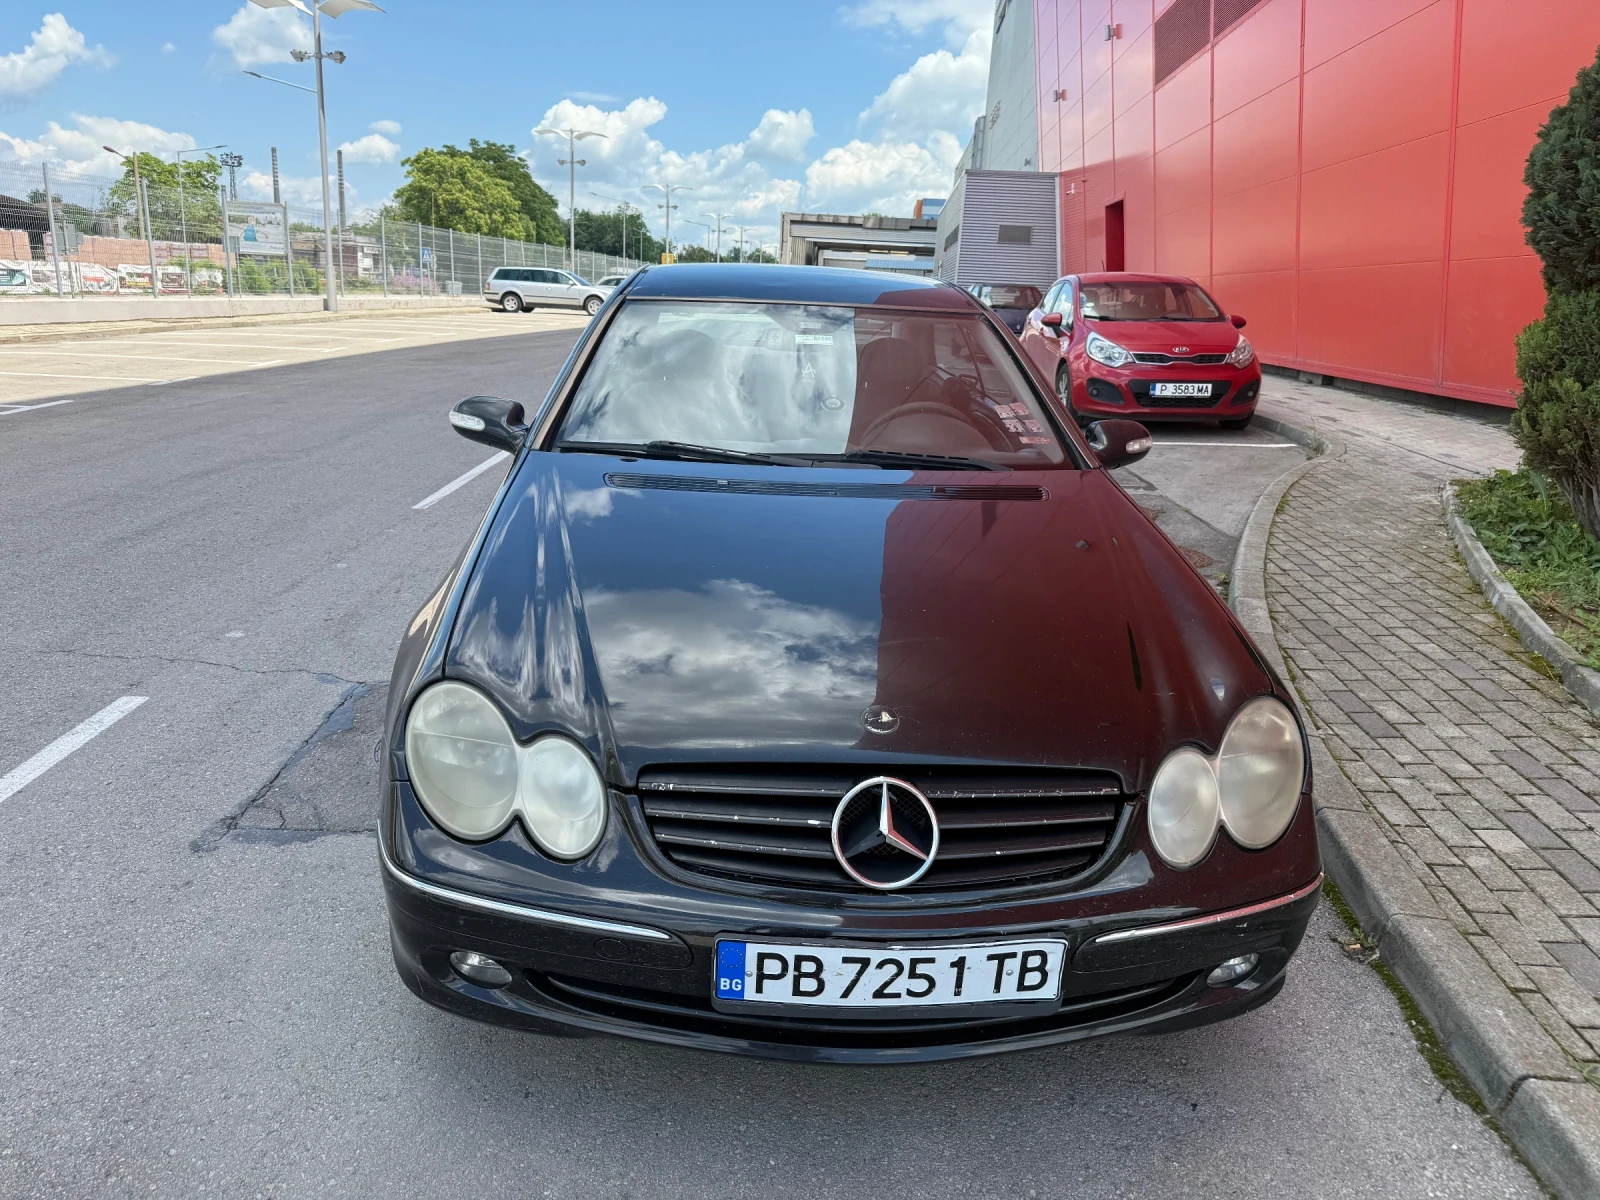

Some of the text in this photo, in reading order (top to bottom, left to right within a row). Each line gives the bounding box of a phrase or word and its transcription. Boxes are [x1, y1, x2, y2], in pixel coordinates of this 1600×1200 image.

[1160, 384, 1167, 394] P
[1172, 385, 1195, 394] 3583
[1197, 385, 1209, 394] MA
[755, 949, 1049, 999] PB 7251 TB
[720, 977, 742, 991] BG
